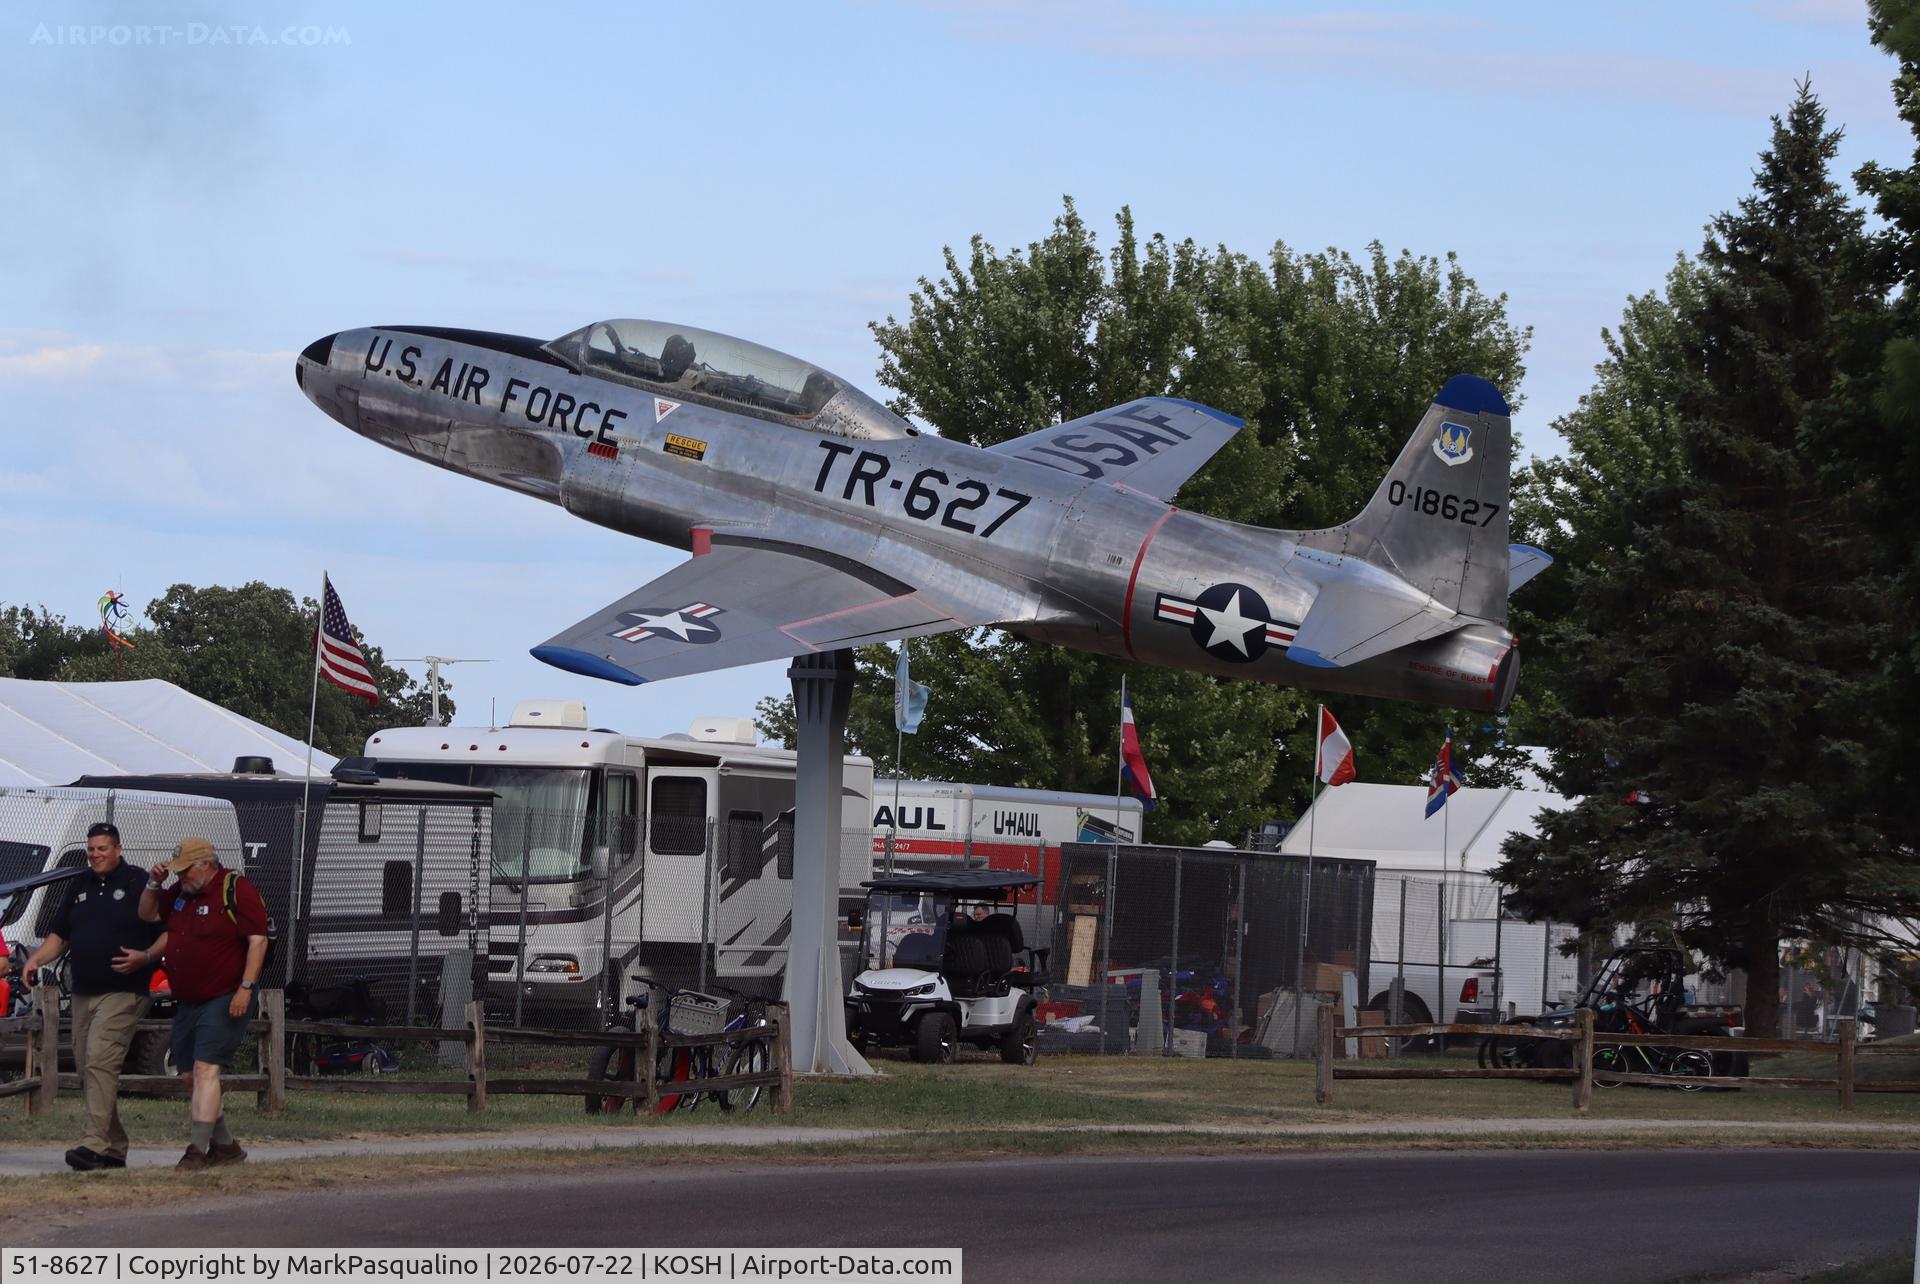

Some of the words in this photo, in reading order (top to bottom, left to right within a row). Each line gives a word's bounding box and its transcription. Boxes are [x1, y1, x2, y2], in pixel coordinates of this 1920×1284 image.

[500, 378, 628, 447] FORCE
[670, 435, 703, 450] RESCUE
[1012, 404, 1193, 480] USAF
[814, 439, 1033, 539] TR-627
[873, 805, 946, 830] AUL
[994, 810, 1041, 837] U-HAUL
[895, 842, 910, 850] 24/7
